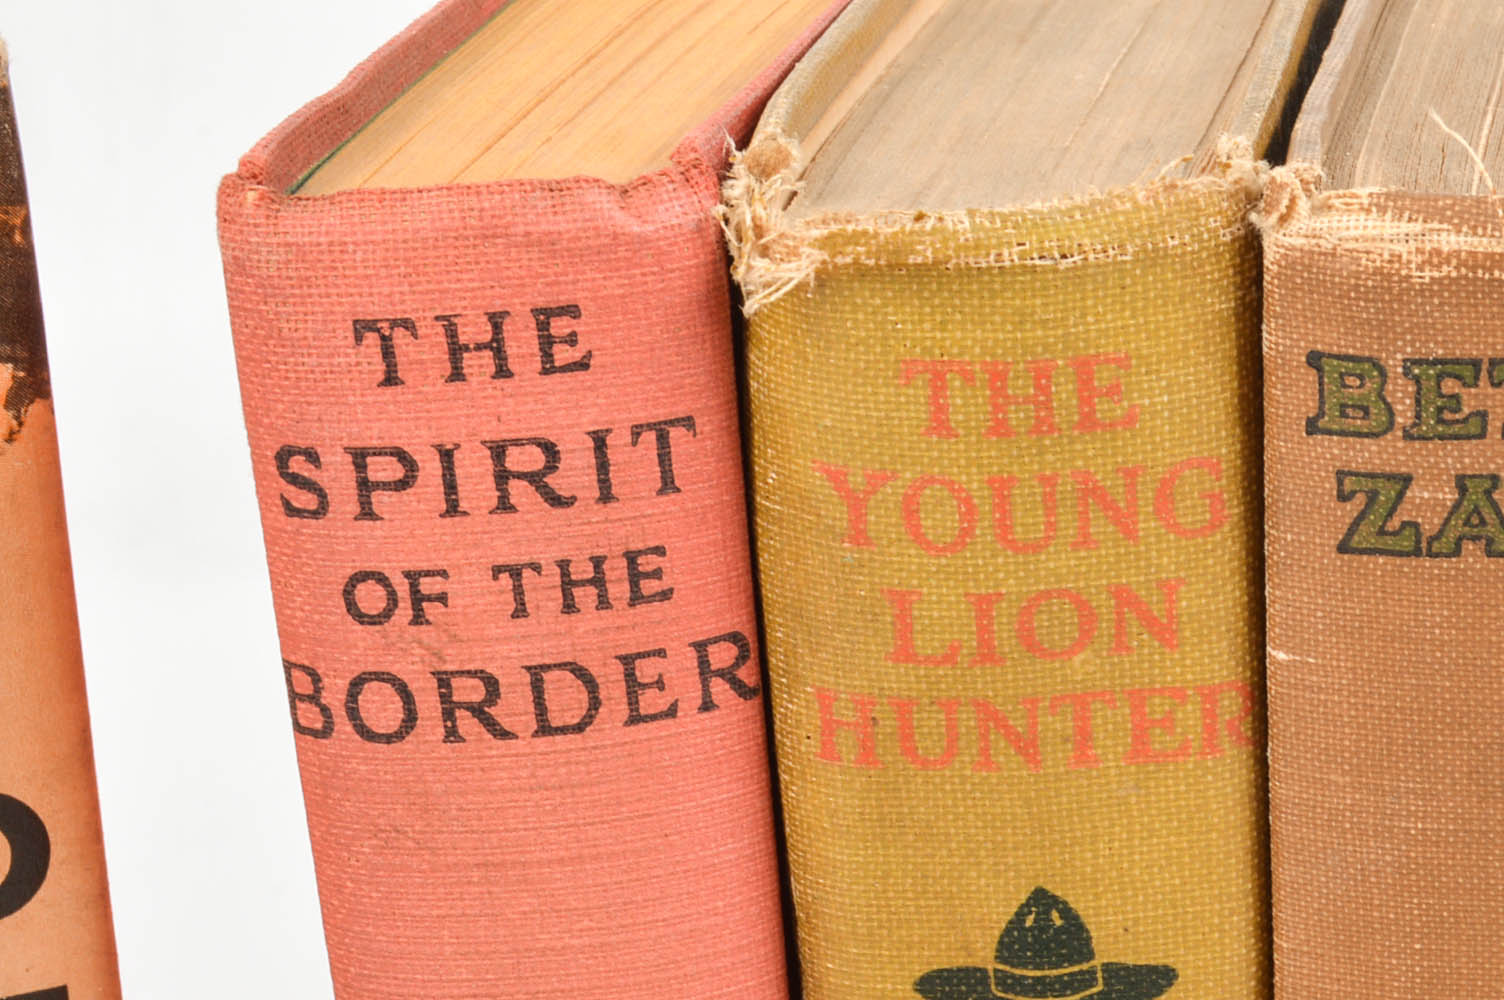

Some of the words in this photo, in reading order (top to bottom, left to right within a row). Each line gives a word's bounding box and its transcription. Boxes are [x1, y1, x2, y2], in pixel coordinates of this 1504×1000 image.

[352, 304, 592, 387] THE
[899, 351, 1140, 440] THE
[273, 415, 697, 521] SPIRIT
[810, 457, 1229, 557] YOUNG
[342, 569, 449, 626] OF
[491, 545, 675, 618] THE
[879, 578, 1188, 669] LION
[282, 630, 761, 745] BORDER
[808, 679, 1255, 774] HUNTER
